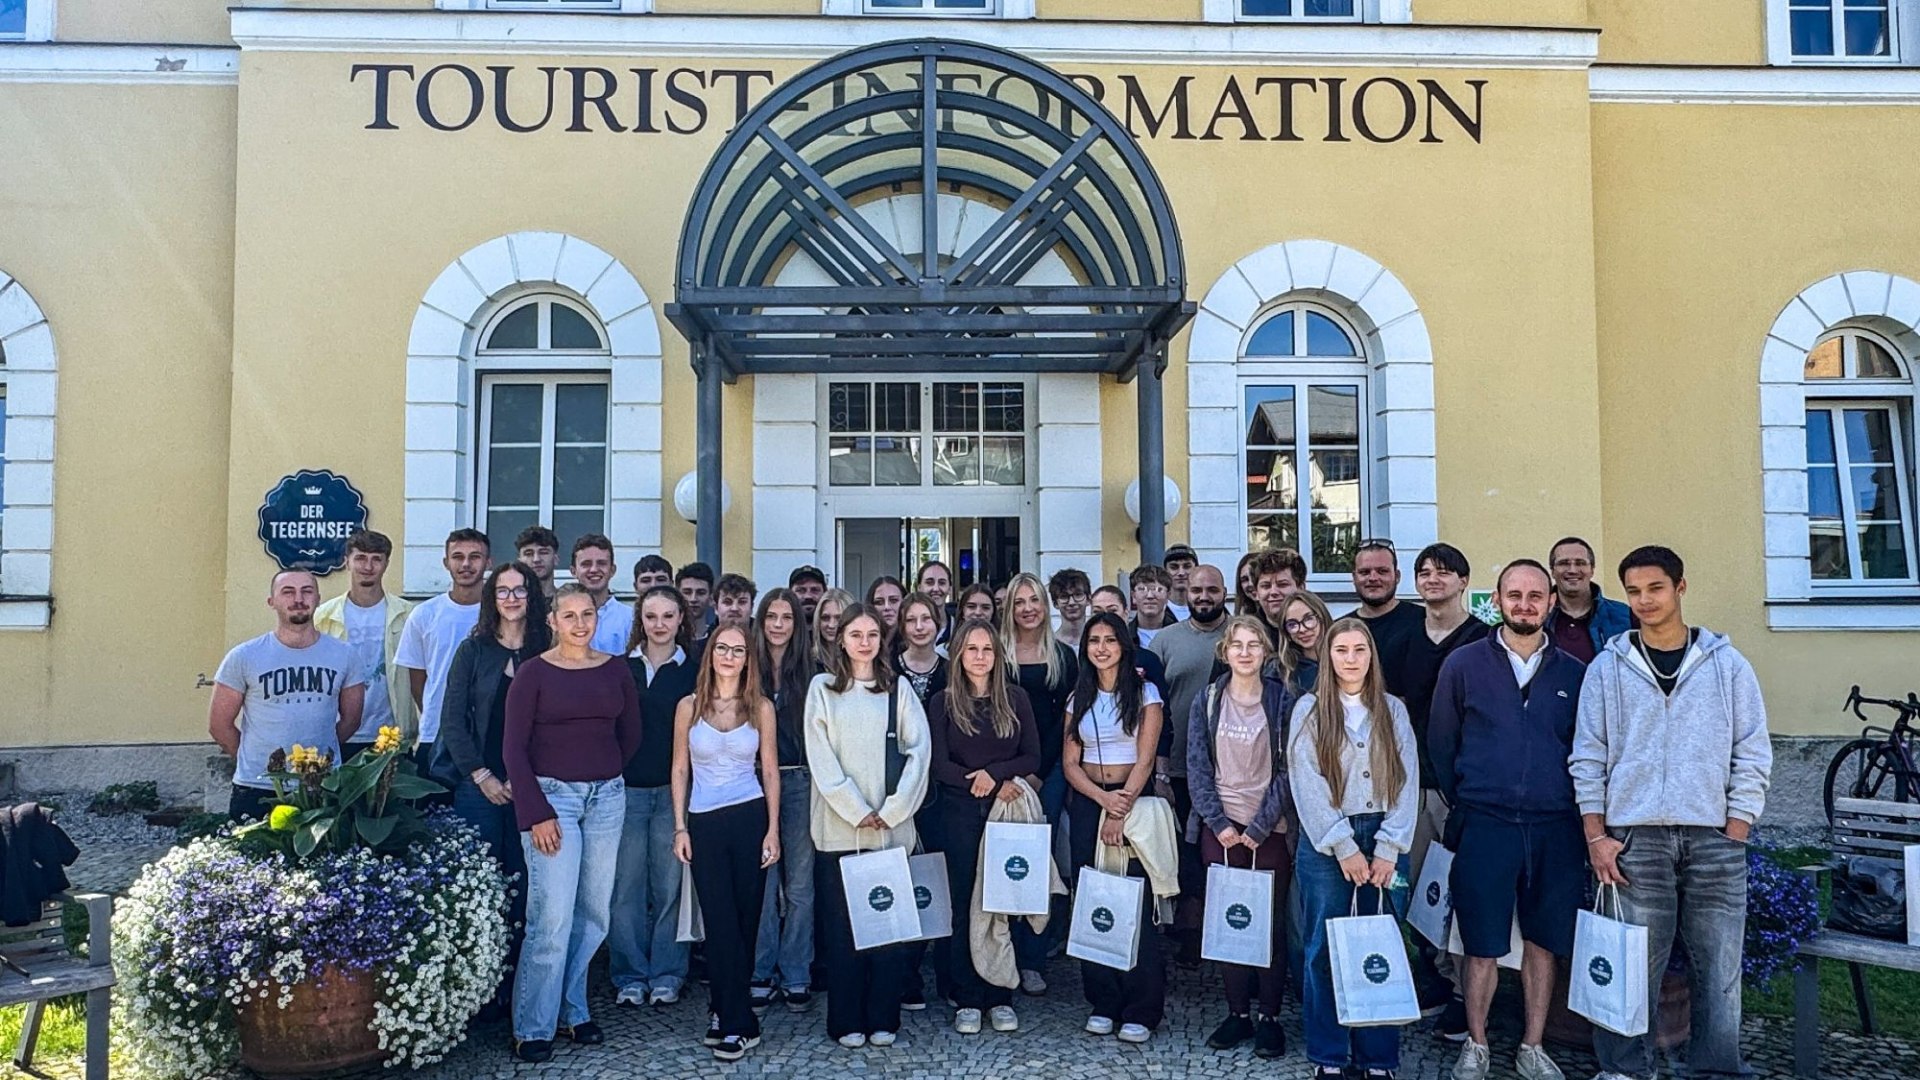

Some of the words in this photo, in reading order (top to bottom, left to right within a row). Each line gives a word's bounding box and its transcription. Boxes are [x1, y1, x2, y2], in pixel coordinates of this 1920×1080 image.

[300, 504, 324, 518] DER
[269, 521, 354, 539] TEGERNSEE
[259, 666, 337, 699] TOMMY
